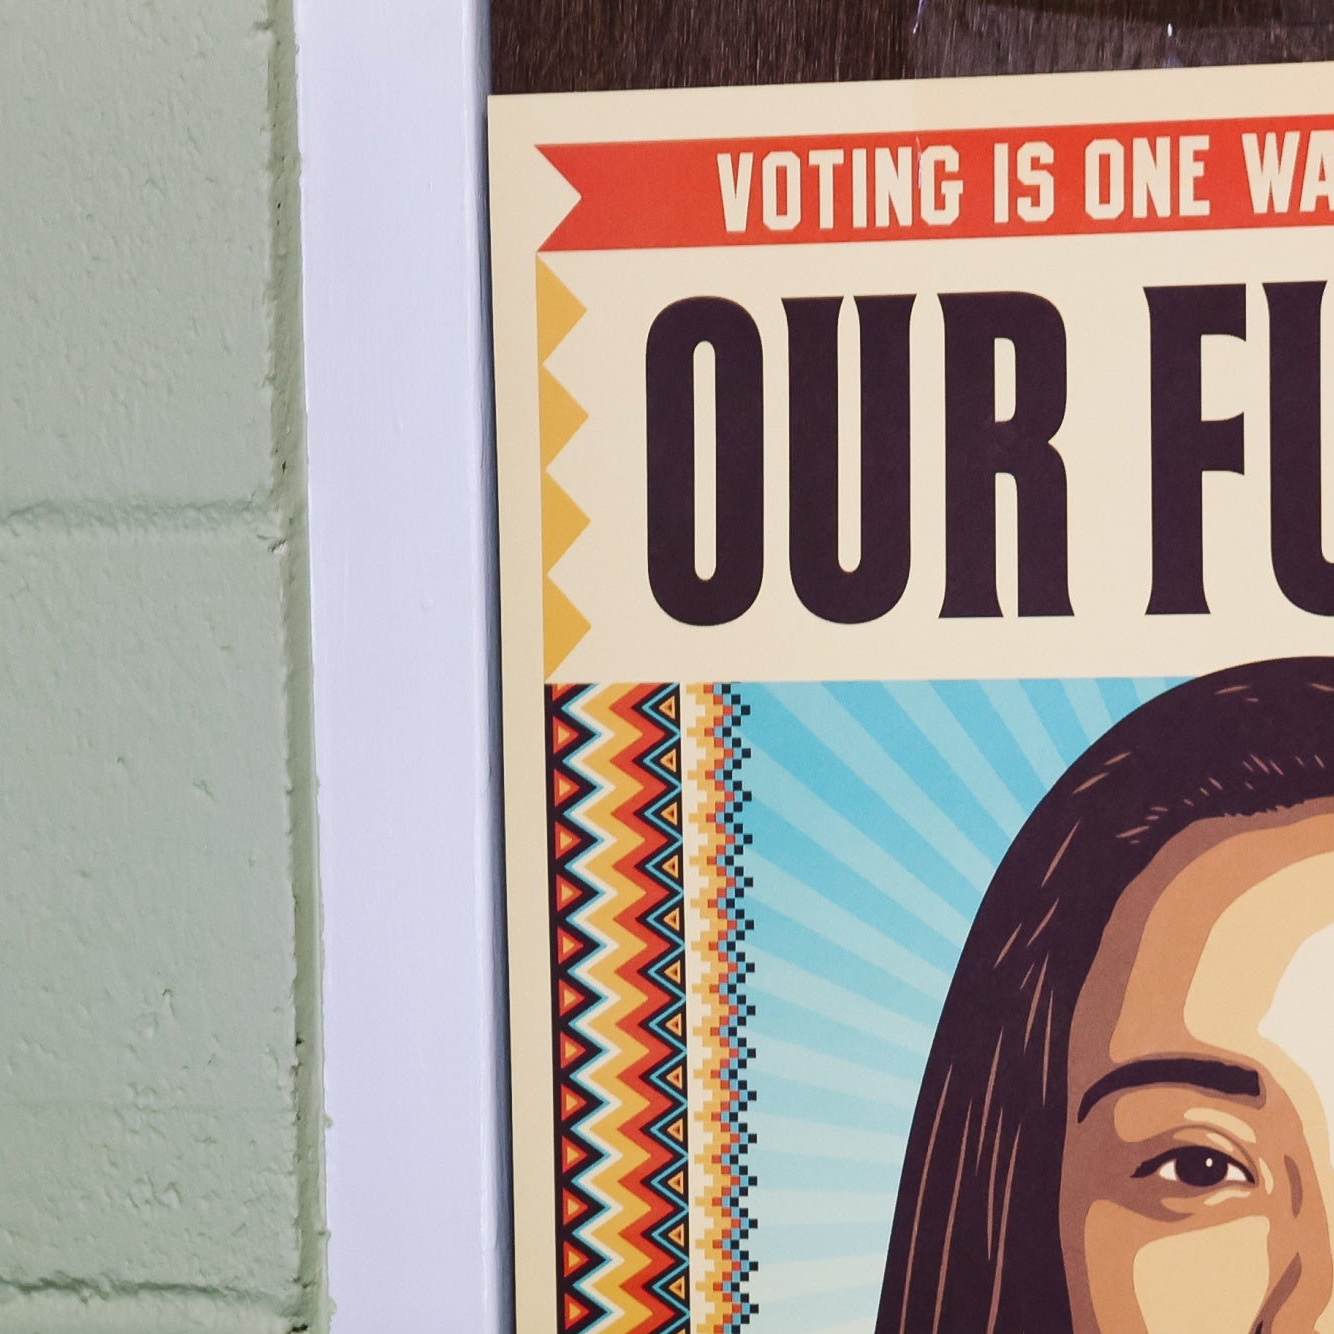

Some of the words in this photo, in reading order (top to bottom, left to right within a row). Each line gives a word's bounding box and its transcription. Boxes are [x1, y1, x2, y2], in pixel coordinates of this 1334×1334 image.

[717, 145, 964, 233] VOTING
[994, 141, 1055, 224] IS
[1084, 136, 1210, 220] ONE
[645, 291, 1075, 627] OUR
